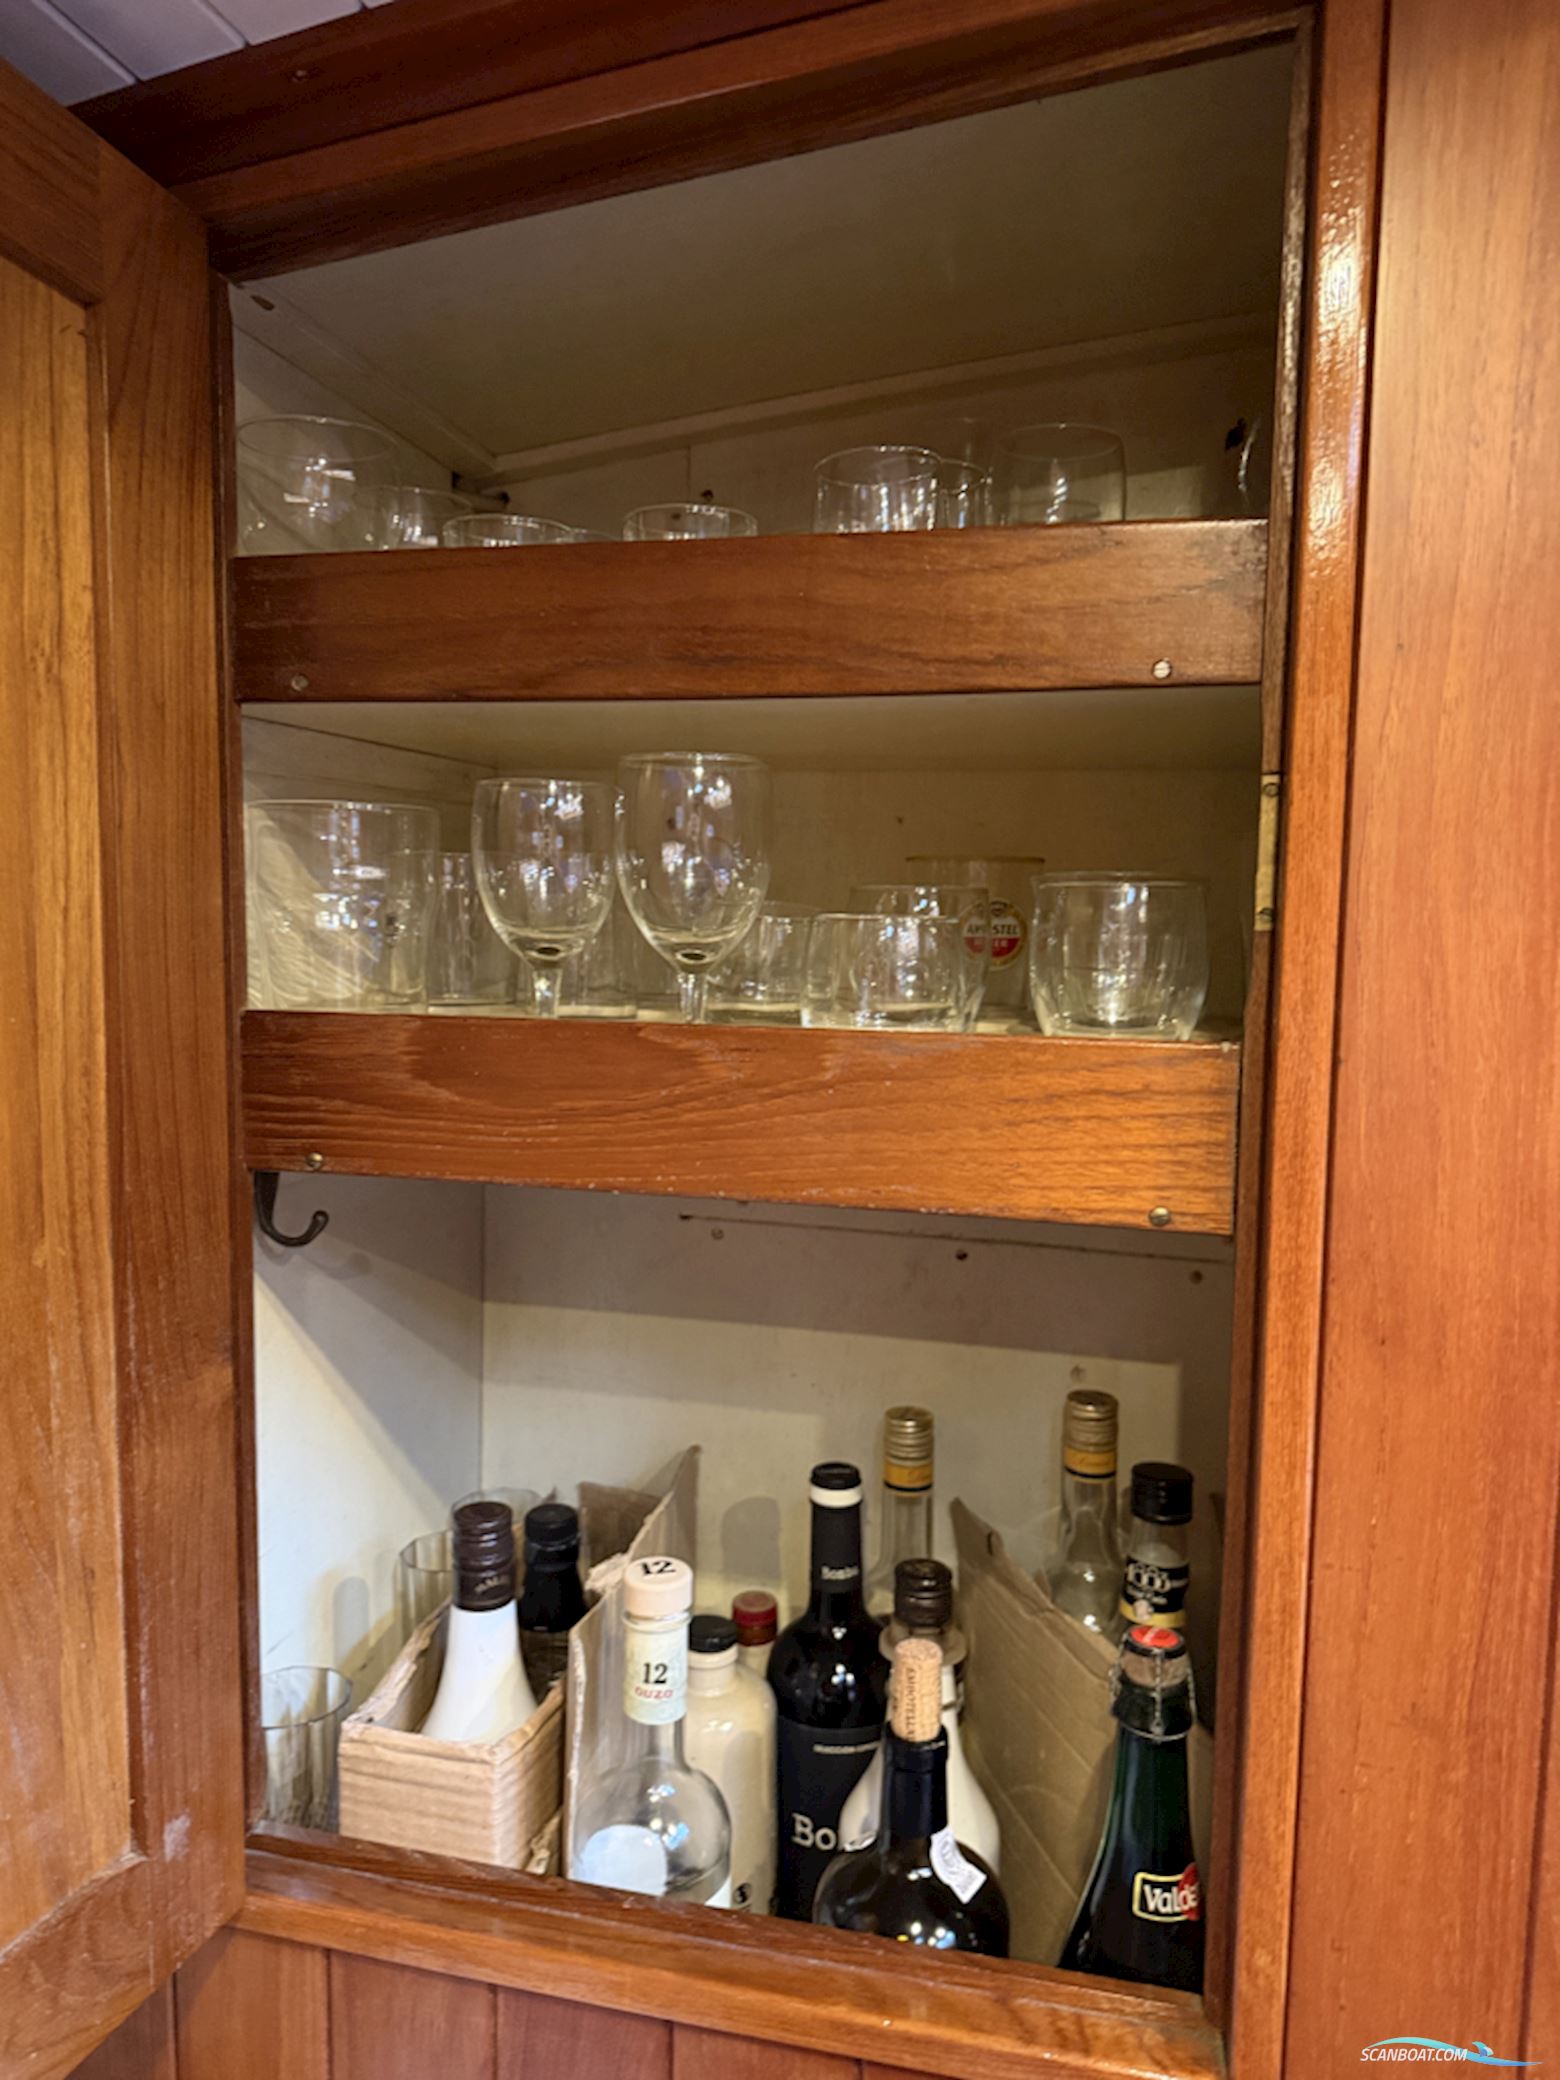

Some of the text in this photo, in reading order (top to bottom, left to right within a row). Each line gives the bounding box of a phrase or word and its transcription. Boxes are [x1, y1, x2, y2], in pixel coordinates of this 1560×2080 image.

[640, 1560, 677, 1576] 12
[642, 1662, 669, 1685] 12
[791, 1811, 840, 1852] Bo
